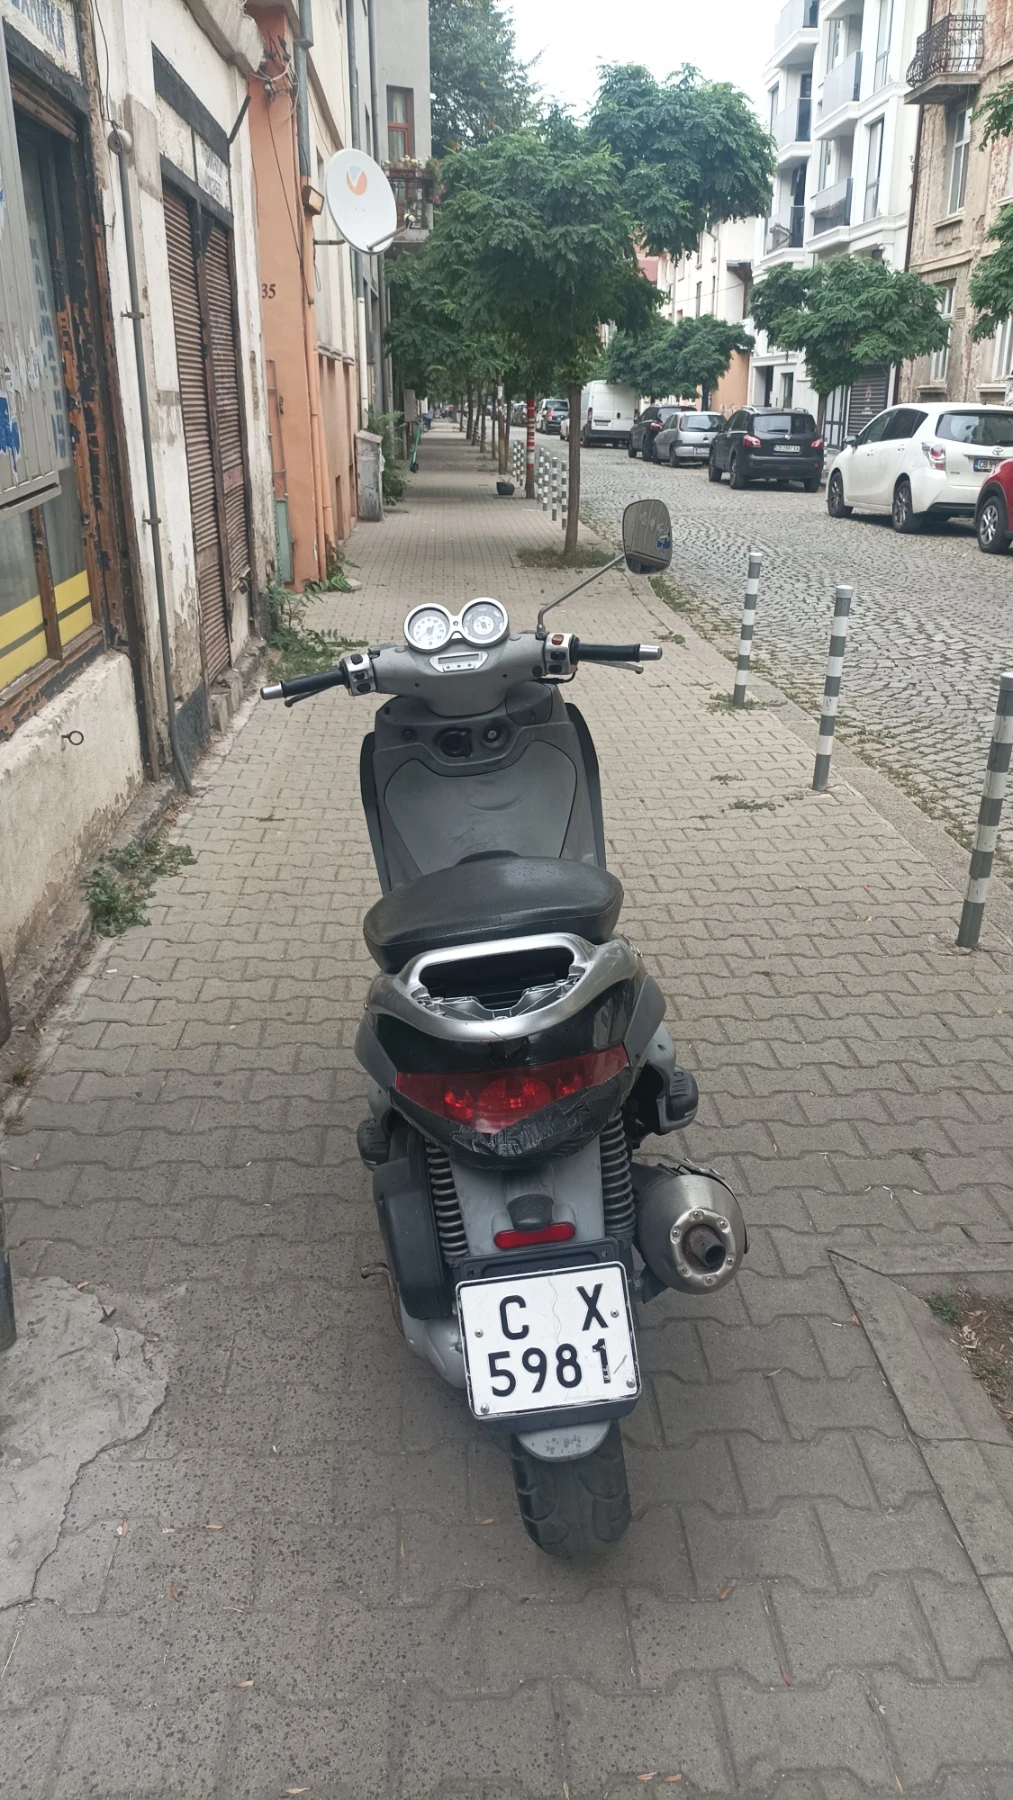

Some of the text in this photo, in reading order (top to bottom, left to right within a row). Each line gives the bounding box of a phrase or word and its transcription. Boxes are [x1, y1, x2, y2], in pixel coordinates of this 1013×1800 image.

[261, 283, 276, 299] 35
[499, 1283, 609, 1340] C X
[488, 1338, 612, 1397] 5981
